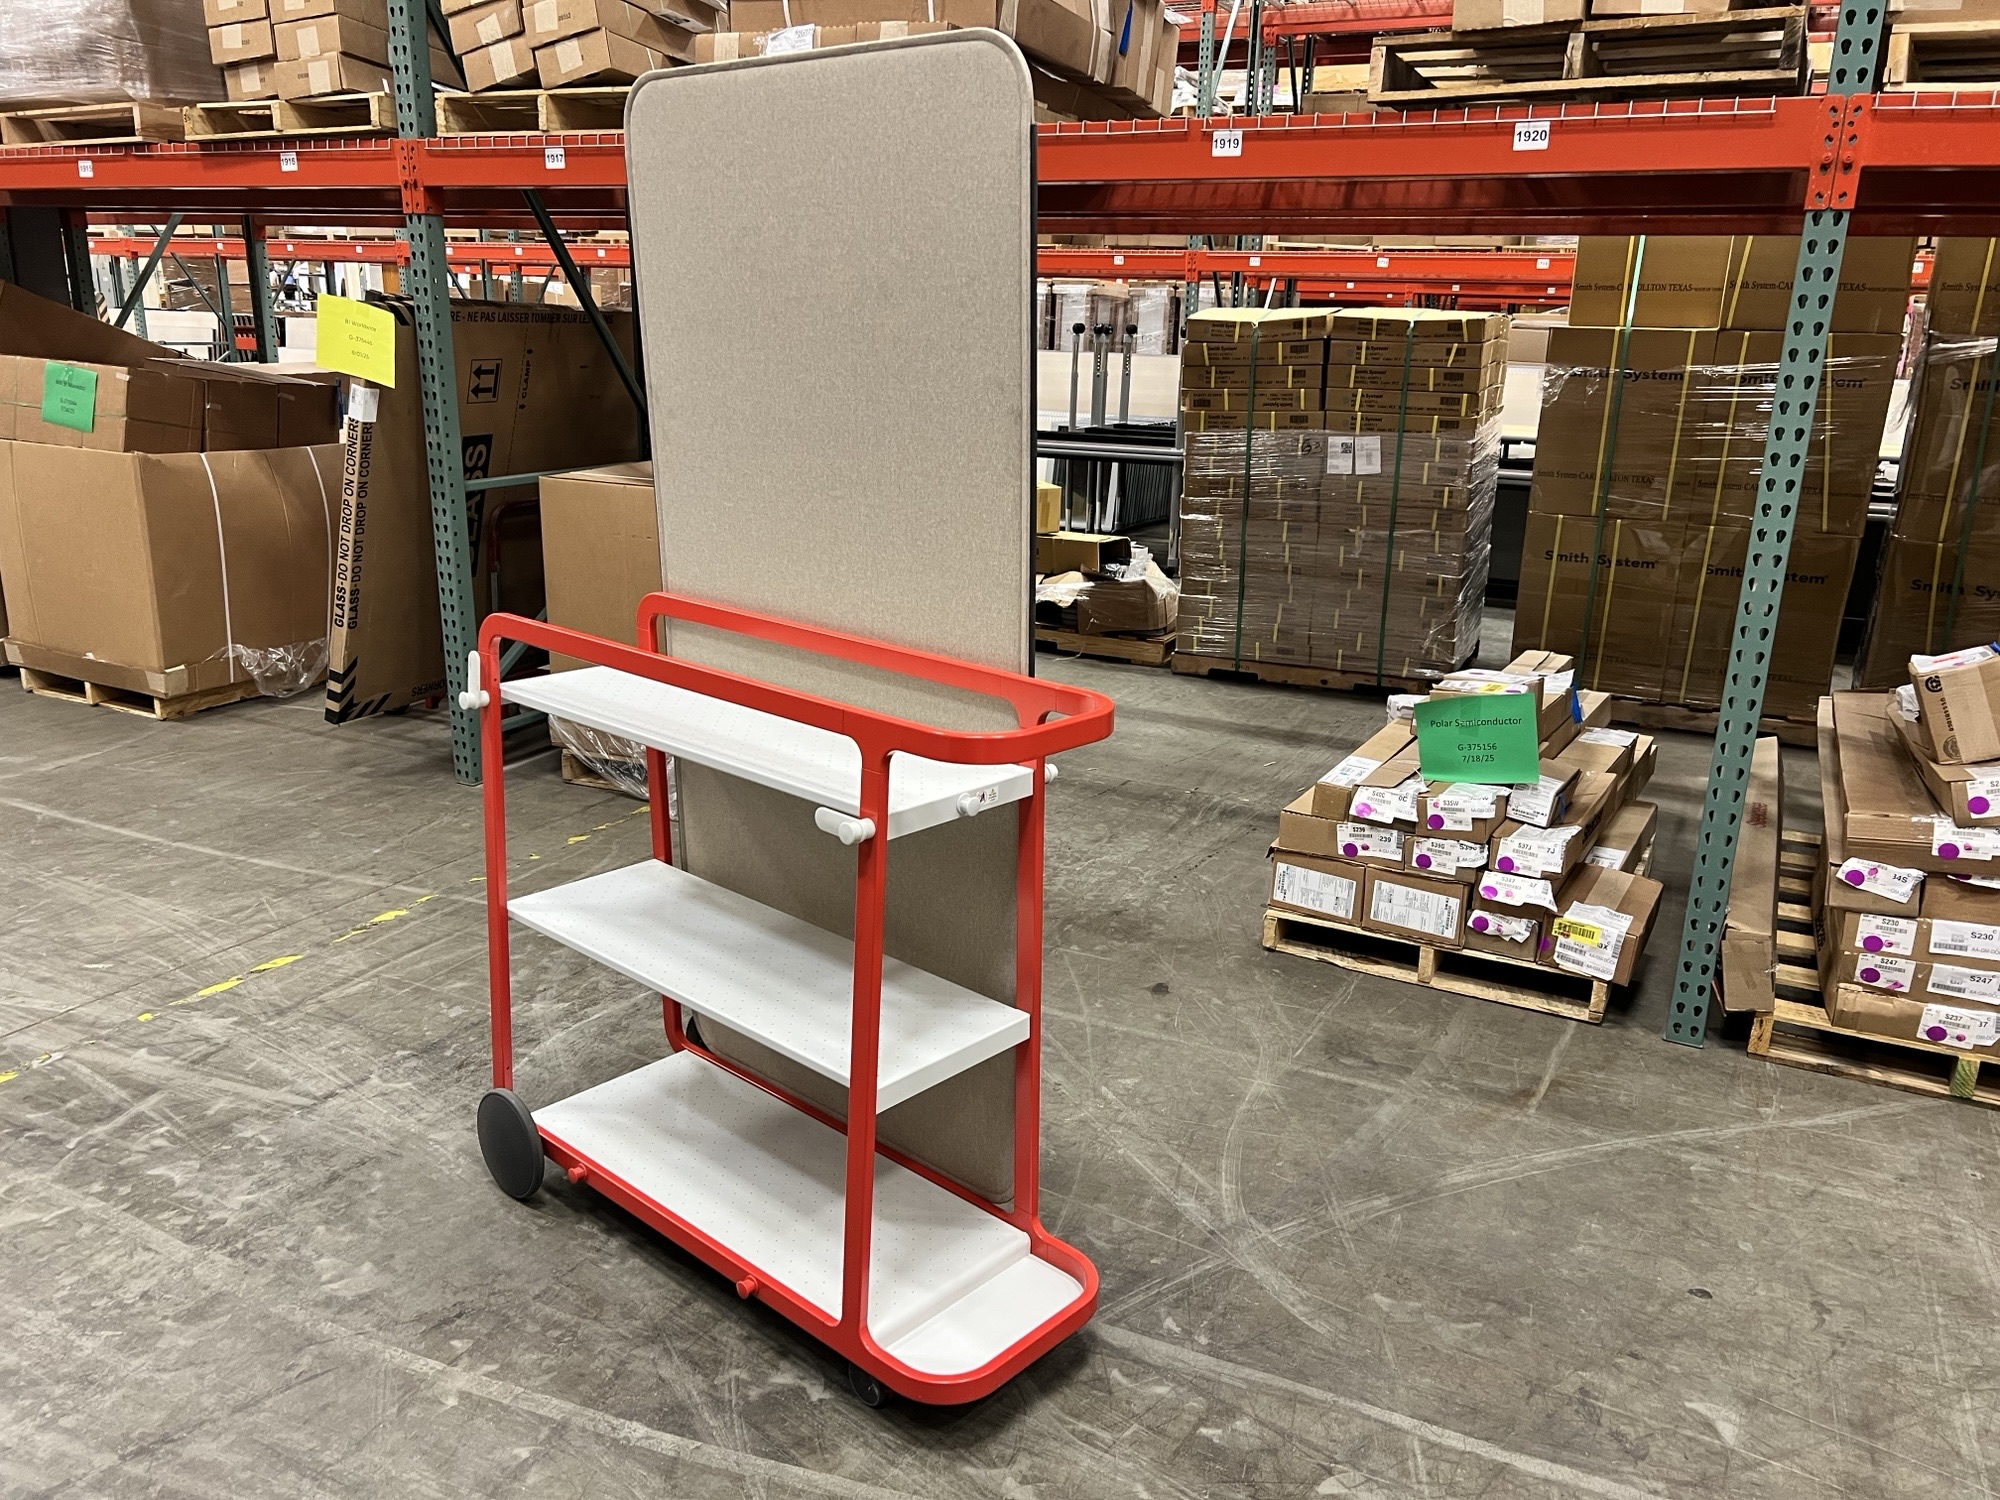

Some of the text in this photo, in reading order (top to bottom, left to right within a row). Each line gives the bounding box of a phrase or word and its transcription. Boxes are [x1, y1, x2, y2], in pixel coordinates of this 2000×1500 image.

[1516, 129, 1548, 143] 1920
[1213, 138, 1239, 149] 1919
[546, 154, 564, 163] 1917
[467, 311, 479, 322] NE
[480, 311, 496, 323] PAS
[497, 312, 529, 323] LAISSER
[530, 313, 561, 324] TOMBER
[562, 313, 577, 324] SUR
[521, 359, 532, 399] CLAMP
[1622, 368, 1684, 383] System
[343, 479, 355, 497] ON
[357, 481, 369, 499] ON
[341, 499, 354, 534] DROP
[355, 502, 368, 535] DROP
[338, 535, 351, 561] NOT
[352, 539, 364, 564] NOT
[1543, 550, 1655, 570] Smith System
[1705, 563, 1743, 578] Smit
[1430, 717, 1522, 728] Polar Semiconductor
[1457, 743, 1498, 752] G-375156
[1462, 754, 1495, 764] 7/18/25
[1881, 918, 1900, 927] S230
[1970, 931, 1994, 941] S230
[1880, 957, 1898, 966] S247
[1969, 975, 1993, 985] S247
[1944, 1013, 1963, 1022] S237
